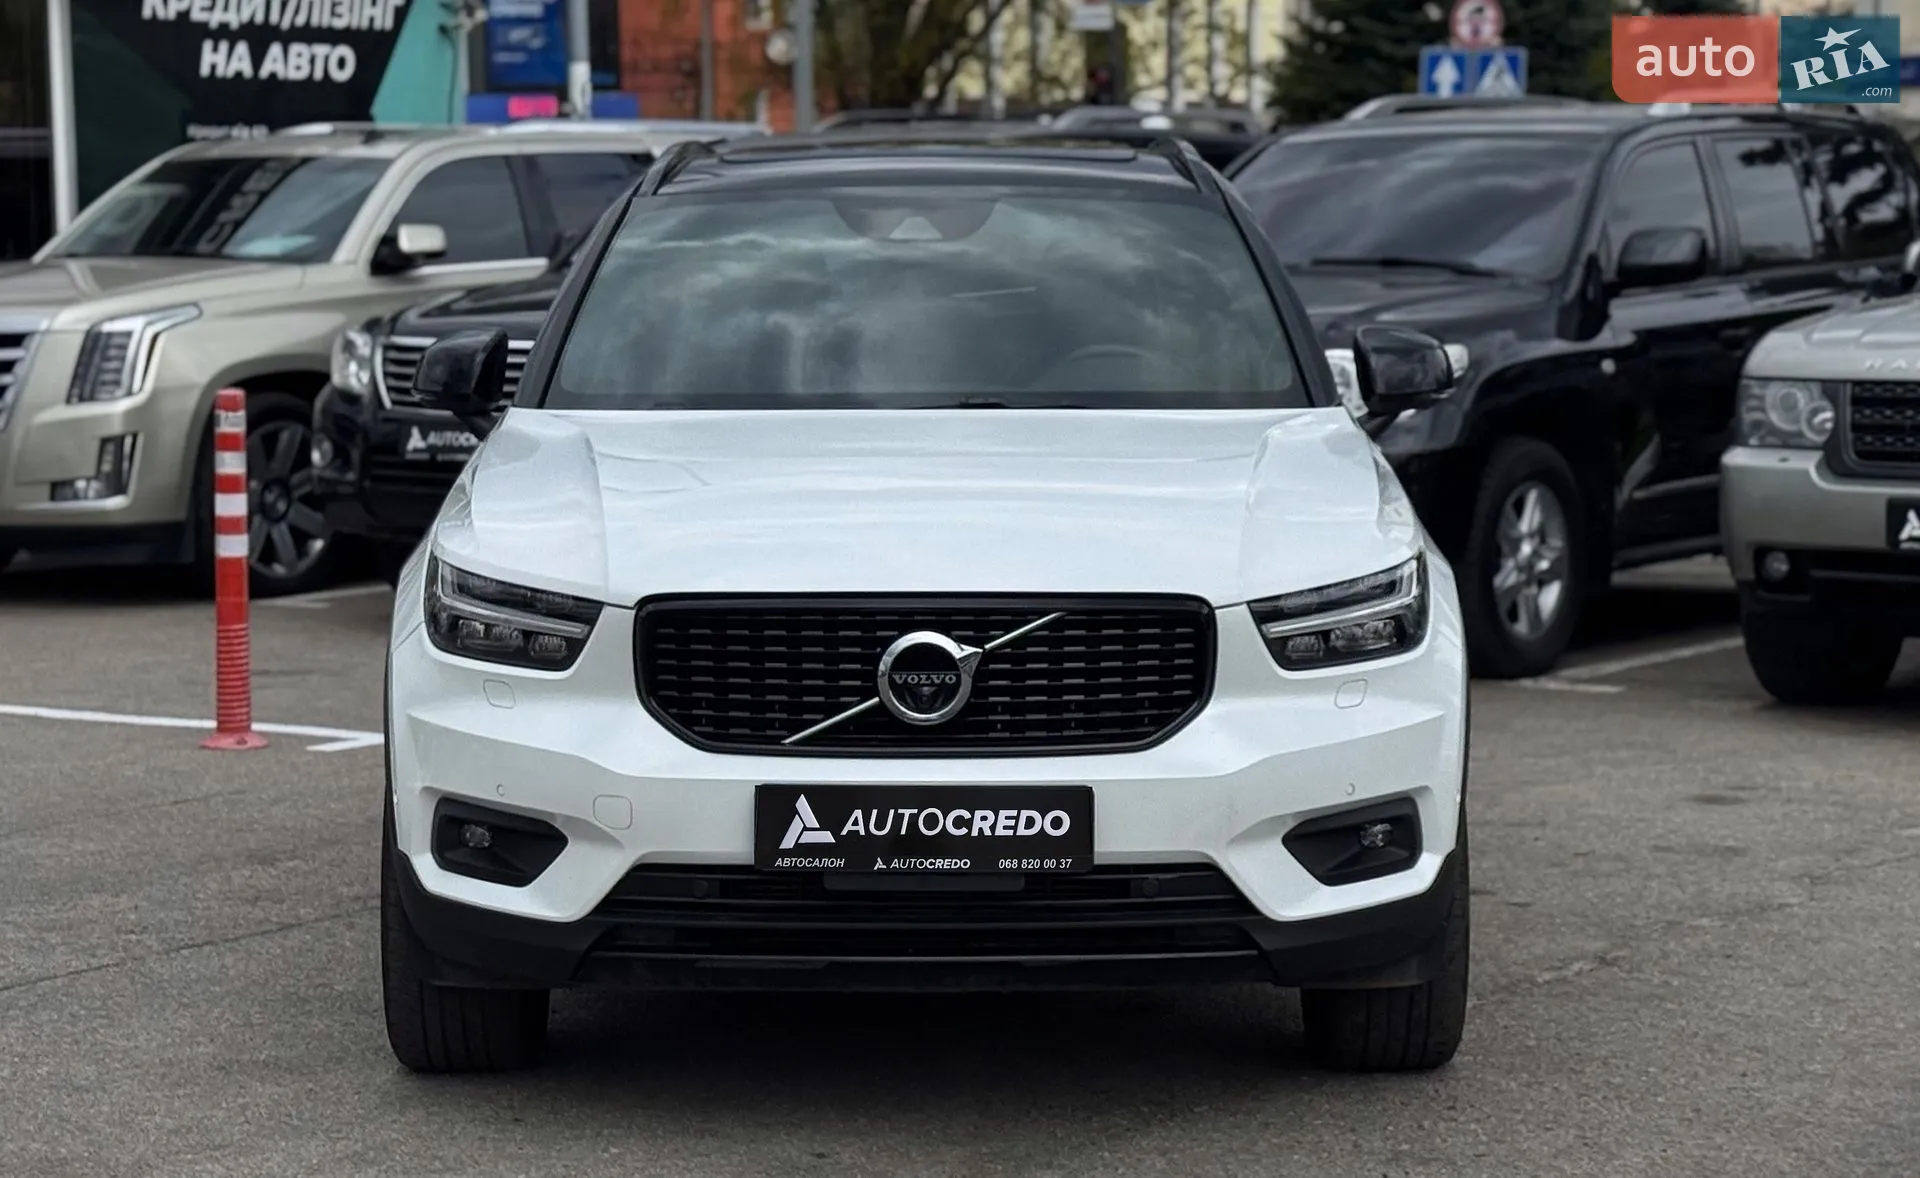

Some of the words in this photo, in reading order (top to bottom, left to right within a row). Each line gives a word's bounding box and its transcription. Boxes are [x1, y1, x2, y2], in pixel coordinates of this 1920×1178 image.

[199, 38, 254, 79] НА
[258, 41, 356, 83] АВТО
[892, 674, 957, 684] VOLVO
[839, 807, 1071, 837] AUTOCREDO
[774, 857, 845, 868] АВТОСАЛОН
[889, 858, 971, 869] AUTOCREDO
[998, 858, 1019, 869] 068
[1021, 858, 1041, 869] 820
[1043, 858, 1057, 869] 00
[1059, 858, 1073, 869] 37
